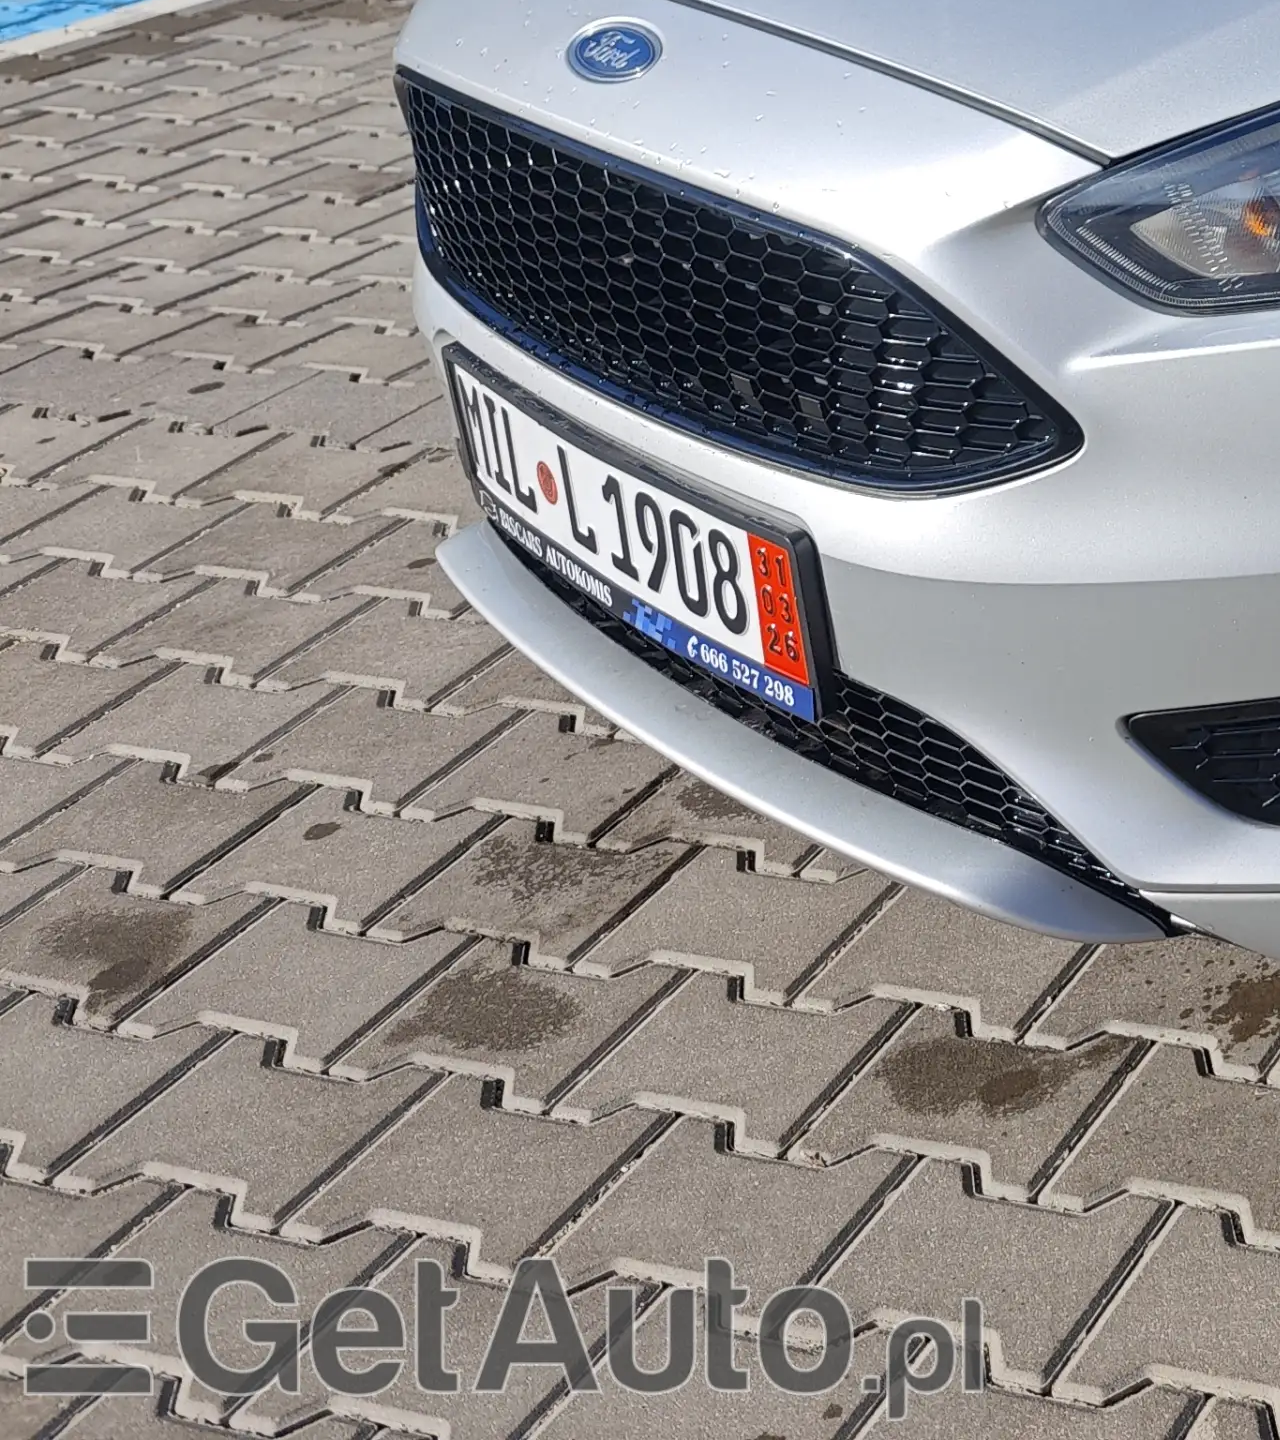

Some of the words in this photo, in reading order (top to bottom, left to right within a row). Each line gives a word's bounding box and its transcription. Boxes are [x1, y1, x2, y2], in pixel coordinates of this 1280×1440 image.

[583, 30, 641, 69] Ford
[457, 373, 538, 514] MIL
[499, 507, 543, 558] BISCARS
[545, 546, 613, 608] AUTOKOMIS
[757, 547, 787, 587] 31
[761, 584, 794, 625] 03
[766, 623, 799, 662] 26
[700, 643, 728, 674] 666
[732, 658, 760, 689] 527
[764, 675, 795, 707] 298
